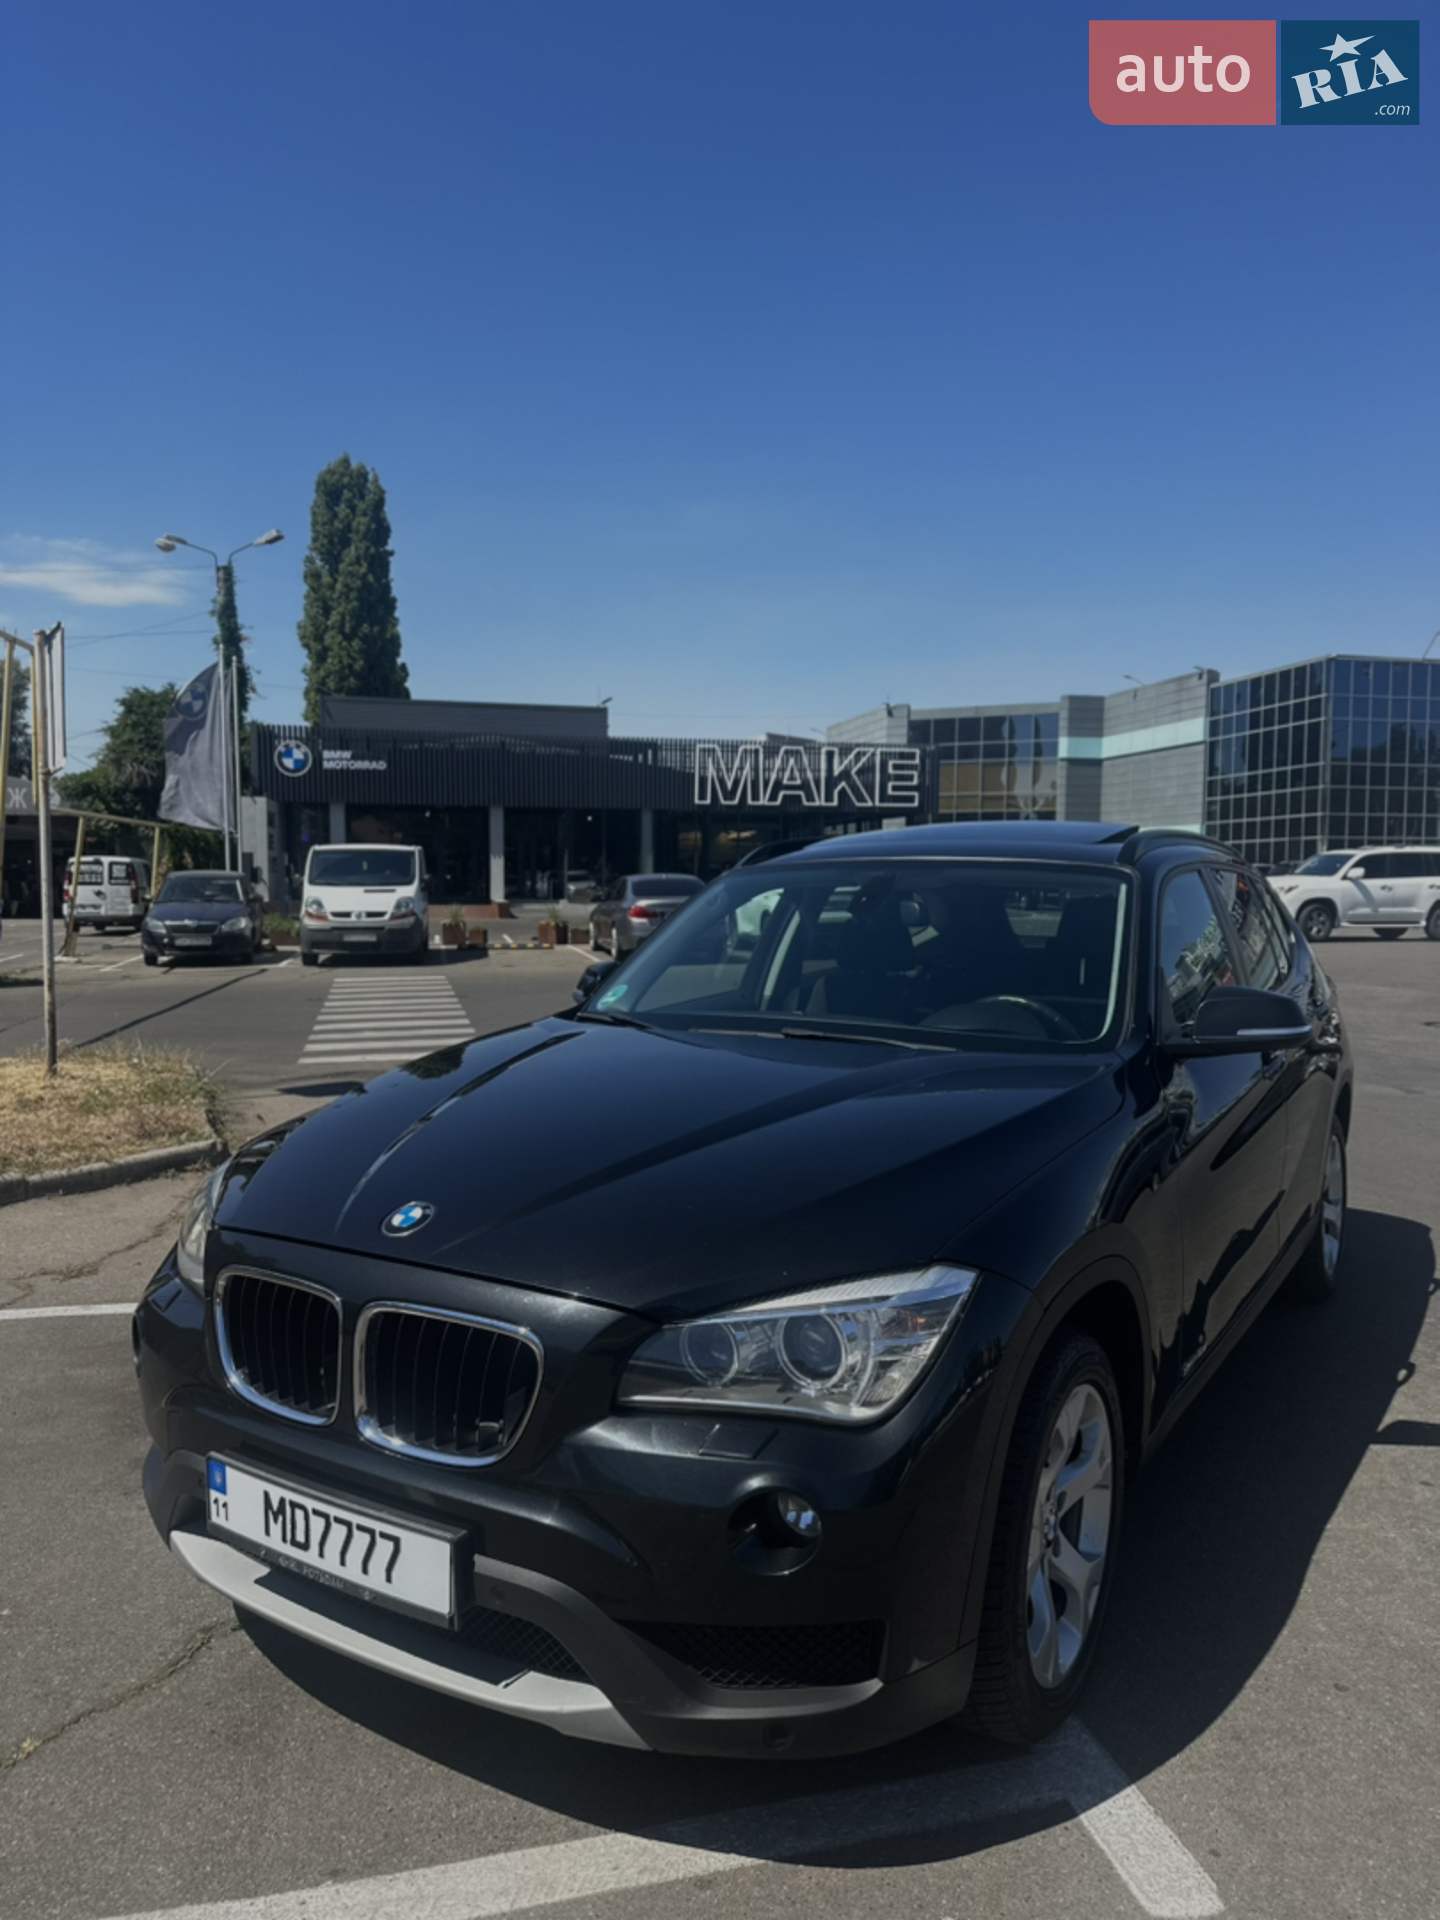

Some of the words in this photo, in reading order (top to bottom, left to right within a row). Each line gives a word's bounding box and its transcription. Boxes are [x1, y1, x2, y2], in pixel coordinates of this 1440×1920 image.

[322, 750, 353, 760] BMW
[322, 760, 387, 770] MOTORRAD
[694, 743, 920, 808] MAKE
[212, 1497, 229, 1522] 11
[263, 1490, 402, 1585] MD7777
